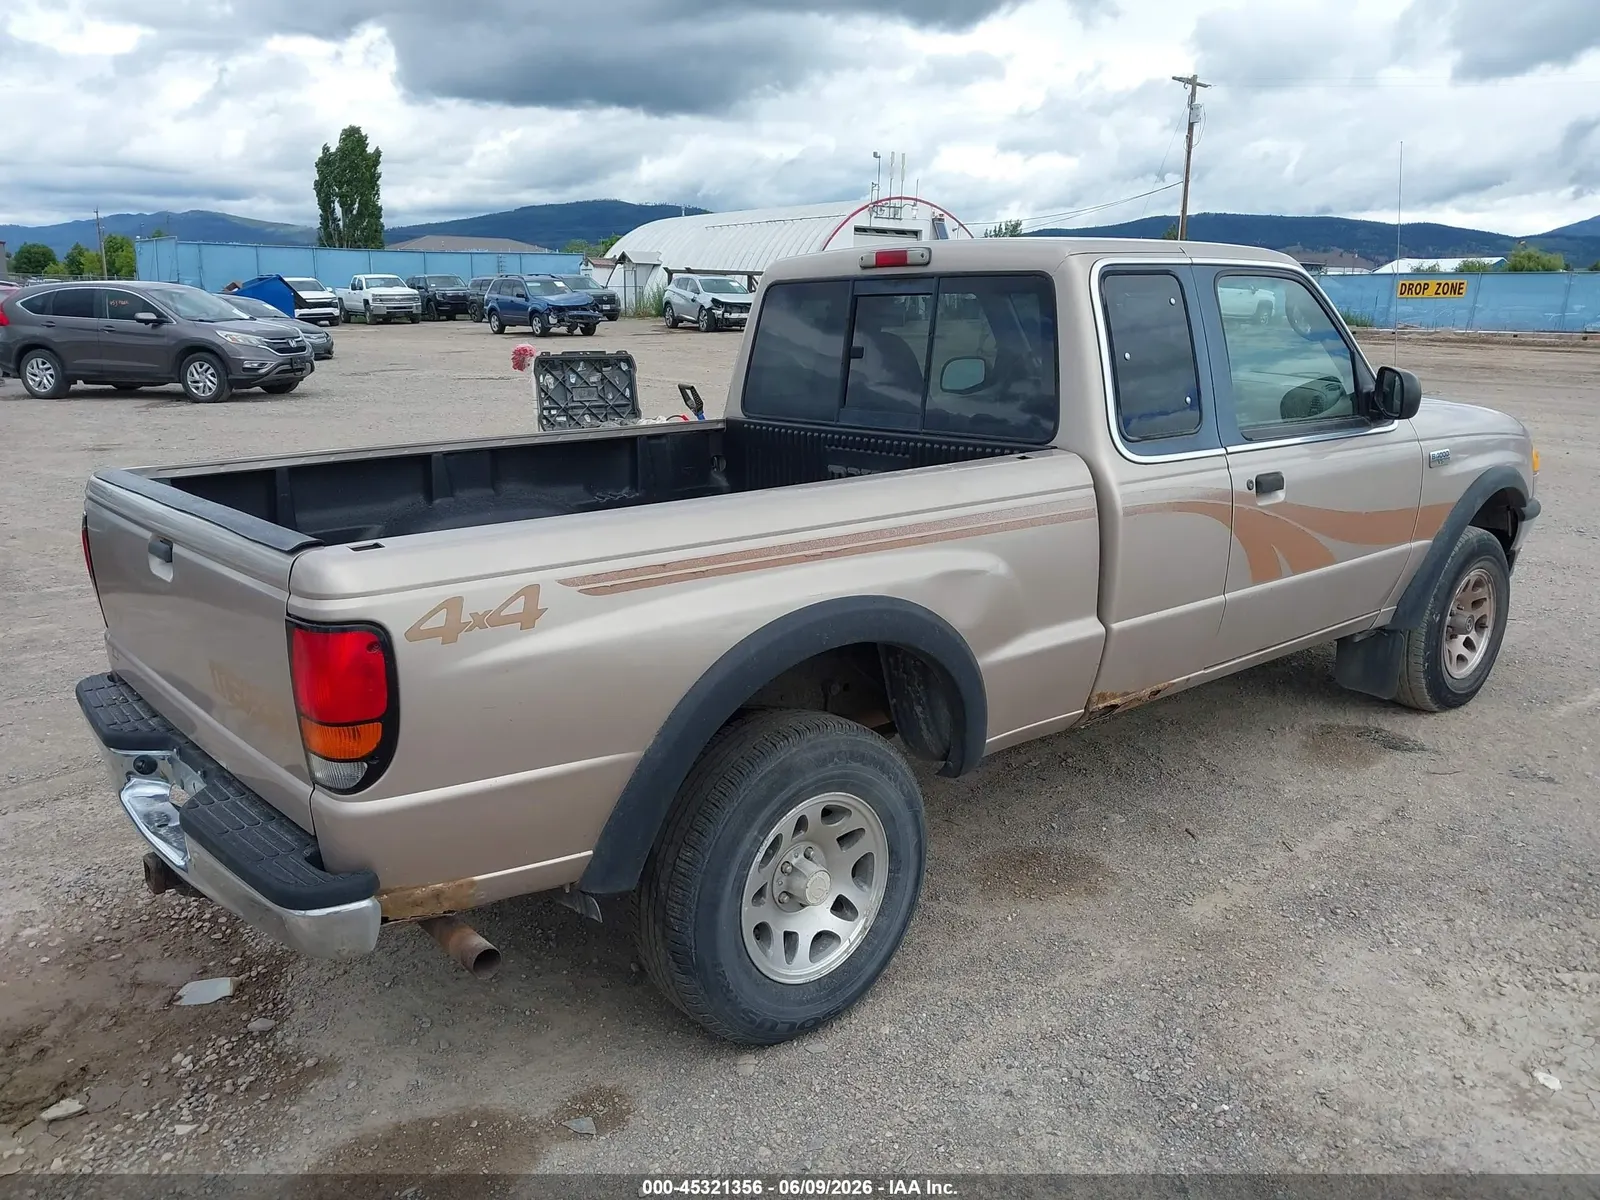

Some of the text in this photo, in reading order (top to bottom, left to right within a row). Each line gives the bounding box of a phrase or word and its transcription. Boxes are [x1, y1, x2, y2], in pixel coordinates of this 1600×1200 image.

[1399, 282, 1465, 296] DROP ZONE
[404, 583, 549, 645] 4x4
